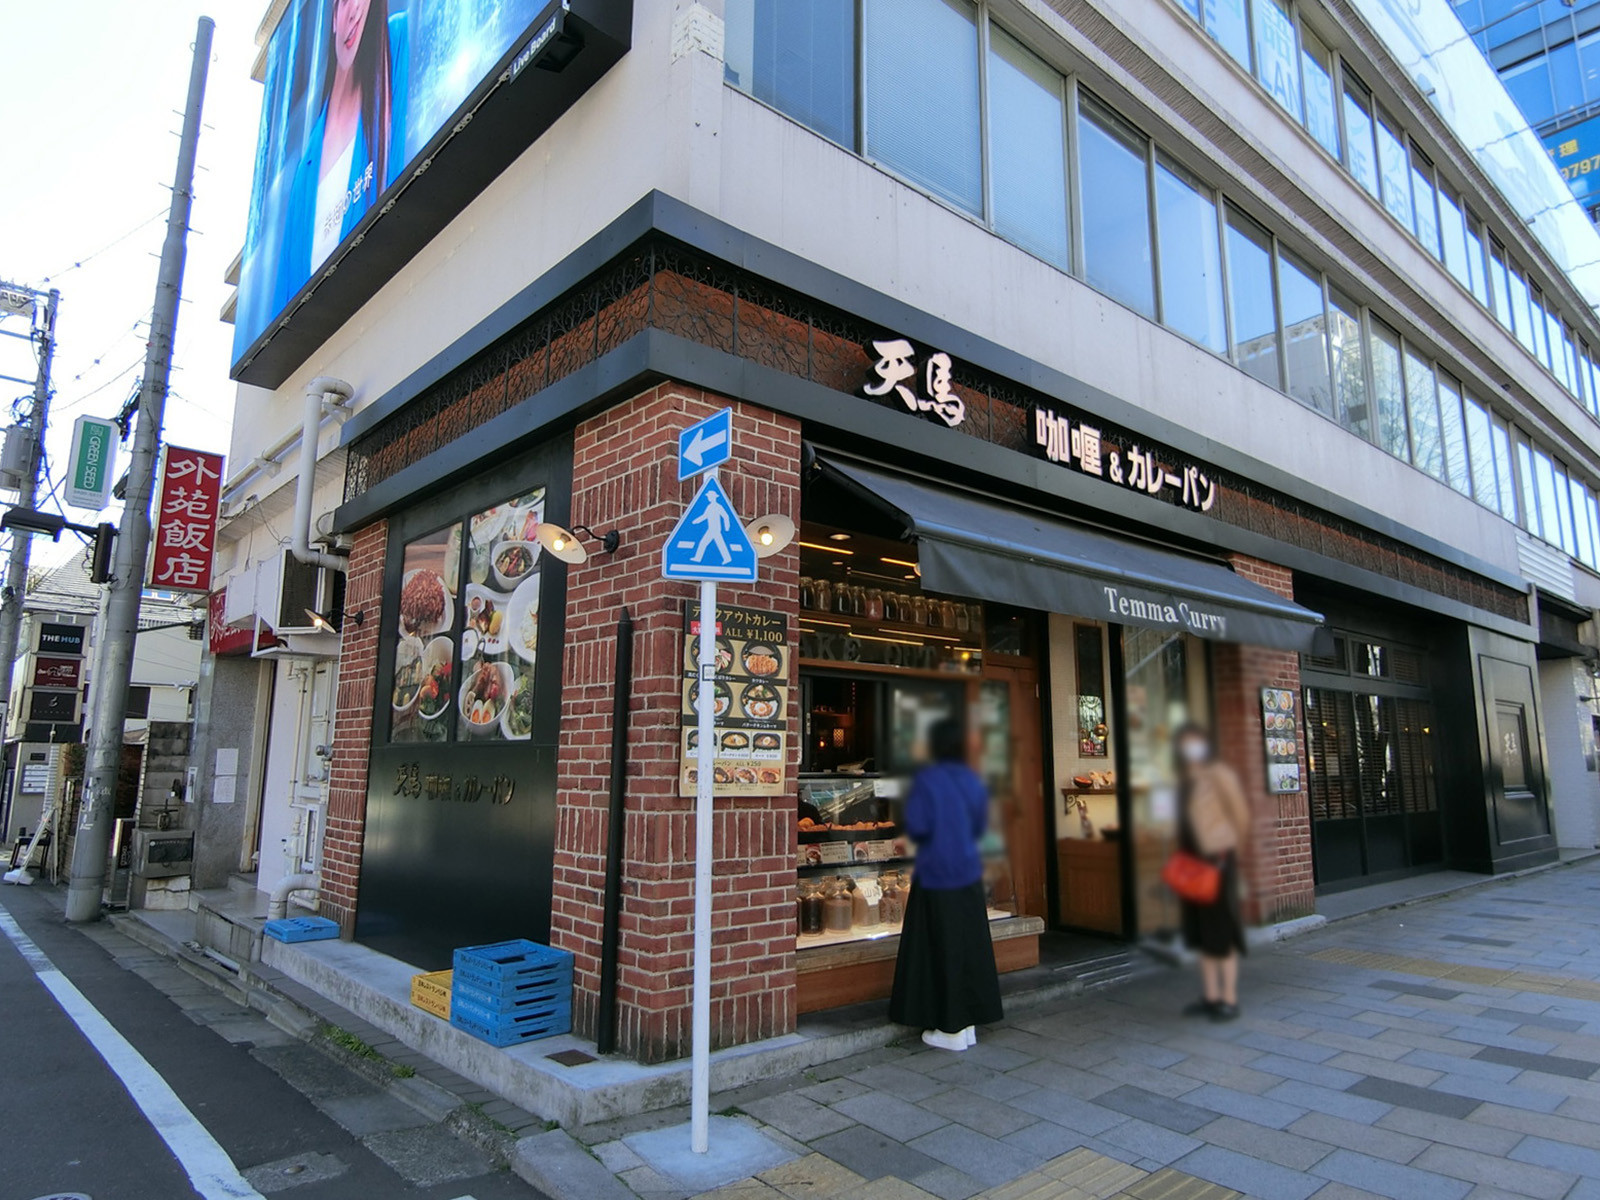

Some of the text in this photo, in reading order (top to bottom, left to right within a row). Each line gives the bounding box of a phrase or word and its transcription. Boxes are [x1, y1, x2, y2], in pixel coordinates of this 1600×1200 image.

[513, 17, 556, 75] Live Board
[863, 339, 966, 427] 天馬
[83, 465, 97, 489] SEED
[87, 436, 101, 466] GREEN
[1109, 451, 1124, 484] &
[1126, 445, 1215, 511] カレーパン
[157, 456, 220, 585] 外苑飯店
[725, 627, 743, 638] ALL
[746, 629, 783, 643] ¥1,100
[1104, 586, 1227, 638] Temma Curry
[42, 634, 81, 644] THE HUB
